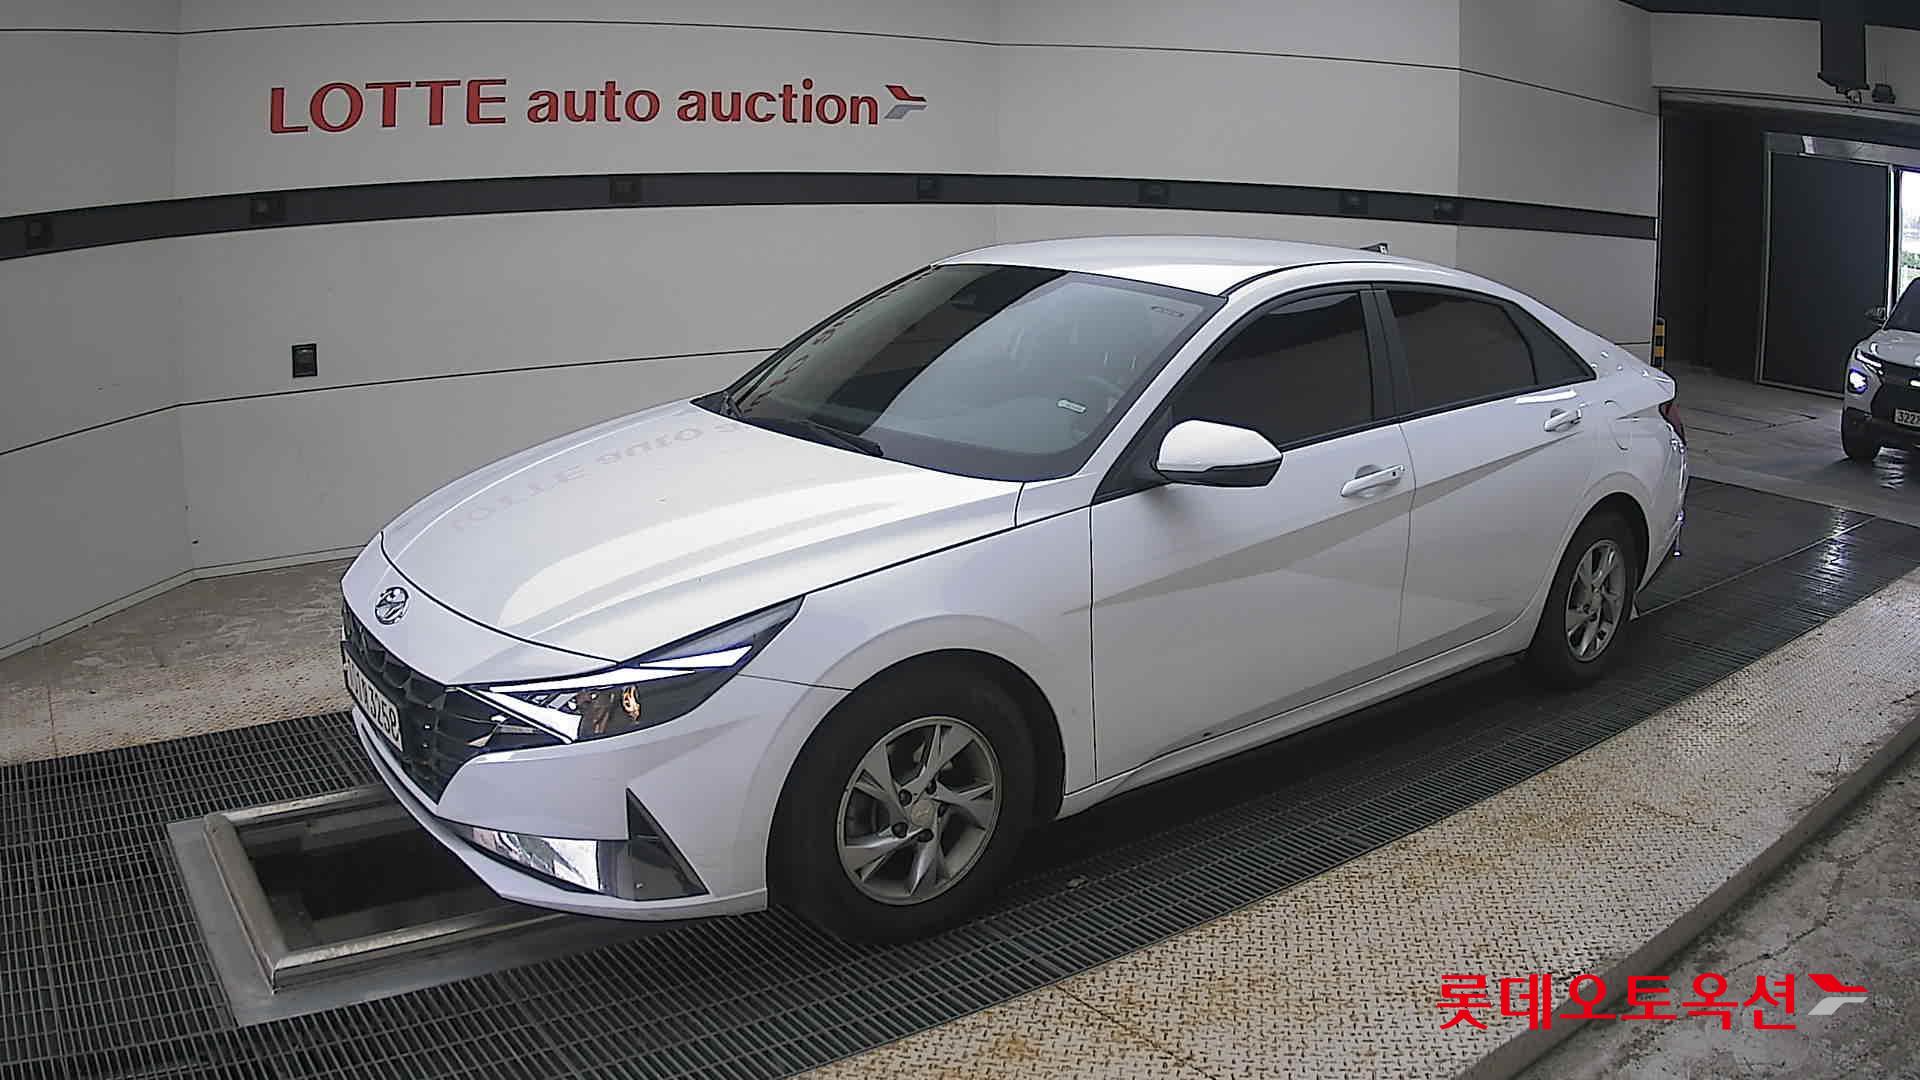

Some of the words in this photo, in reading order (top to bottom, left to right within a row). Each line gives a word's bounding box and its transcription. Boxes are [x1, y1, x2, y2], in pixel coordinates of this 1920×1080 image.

[270, 79, 506, 134] LOTTE
[527, 80, 661, 123] auto
[676, 78, 880, 126] auction
